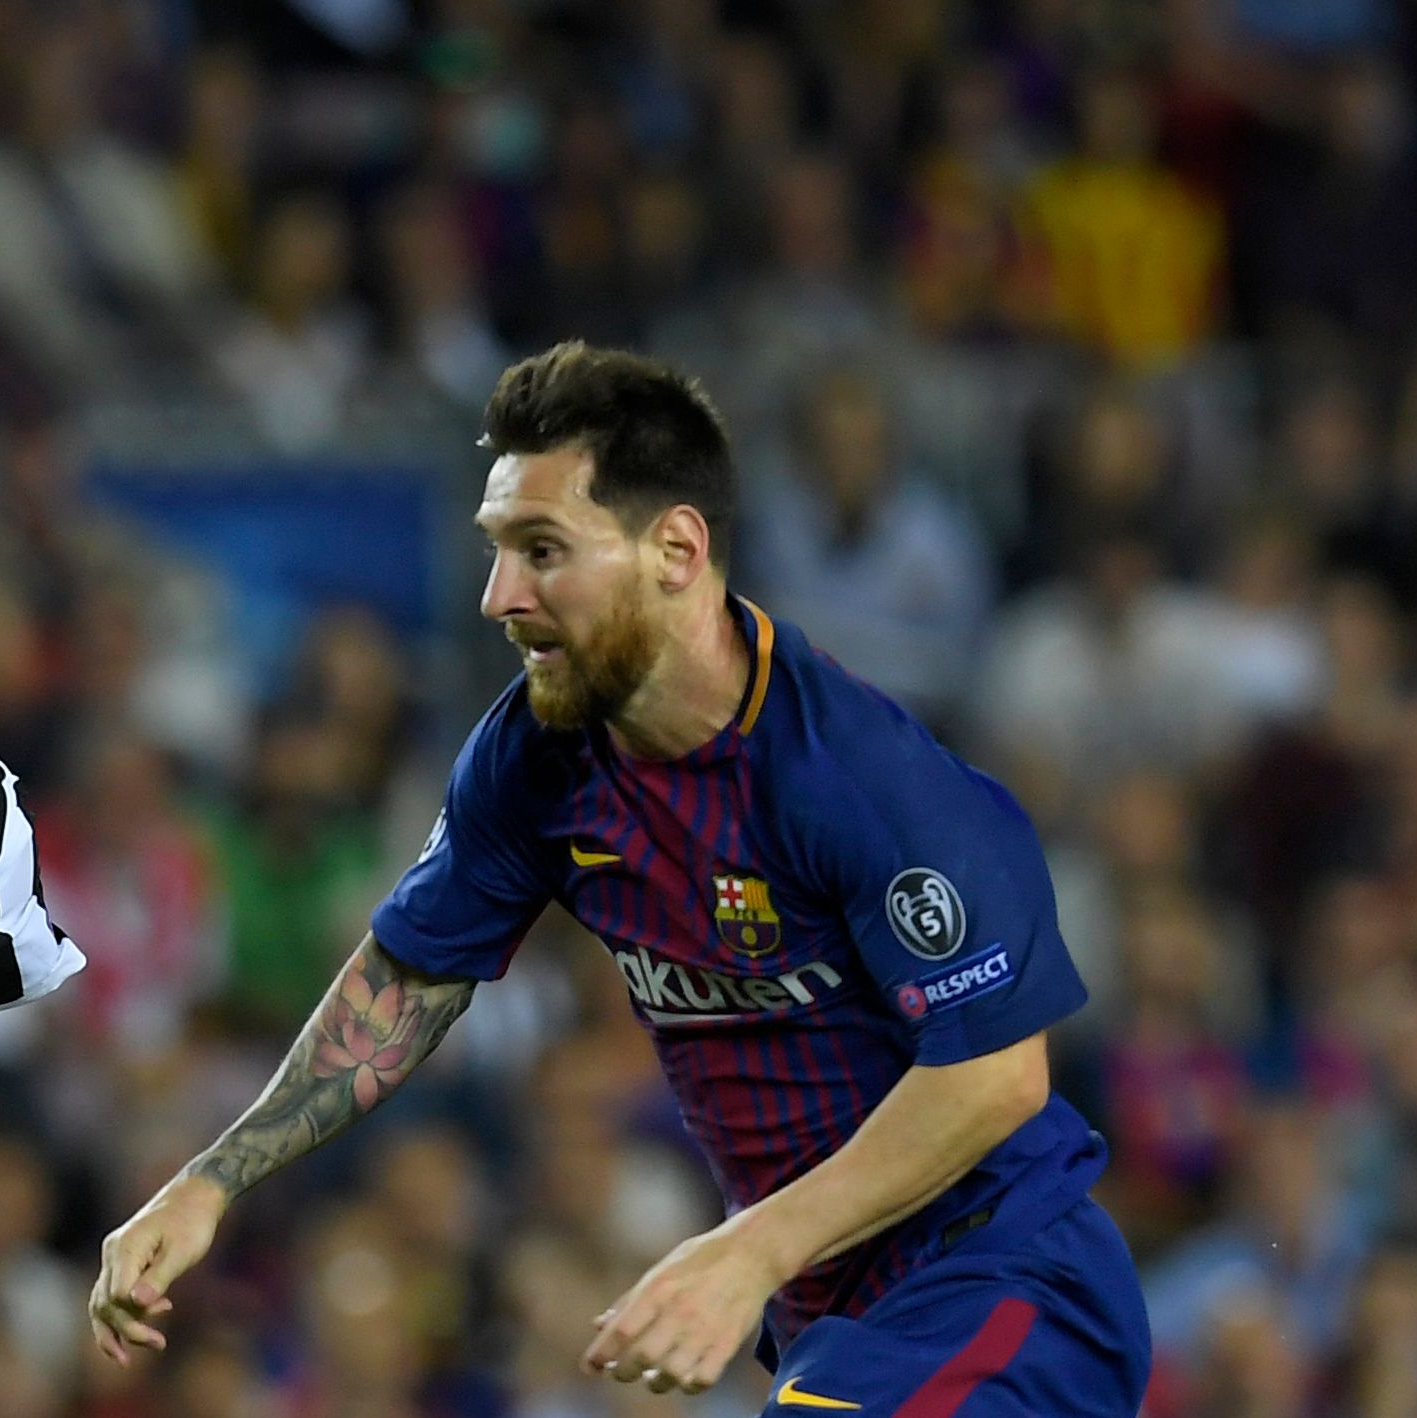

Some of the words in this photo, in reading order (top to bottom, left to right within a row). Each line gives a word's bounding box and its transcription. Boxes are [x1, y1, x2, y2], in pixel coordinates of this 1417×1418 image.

[920, 910, 942, 938] 5
[616, 946, 843, 1011] akuten
[924, 951, 1009, 1004] RESPECT
